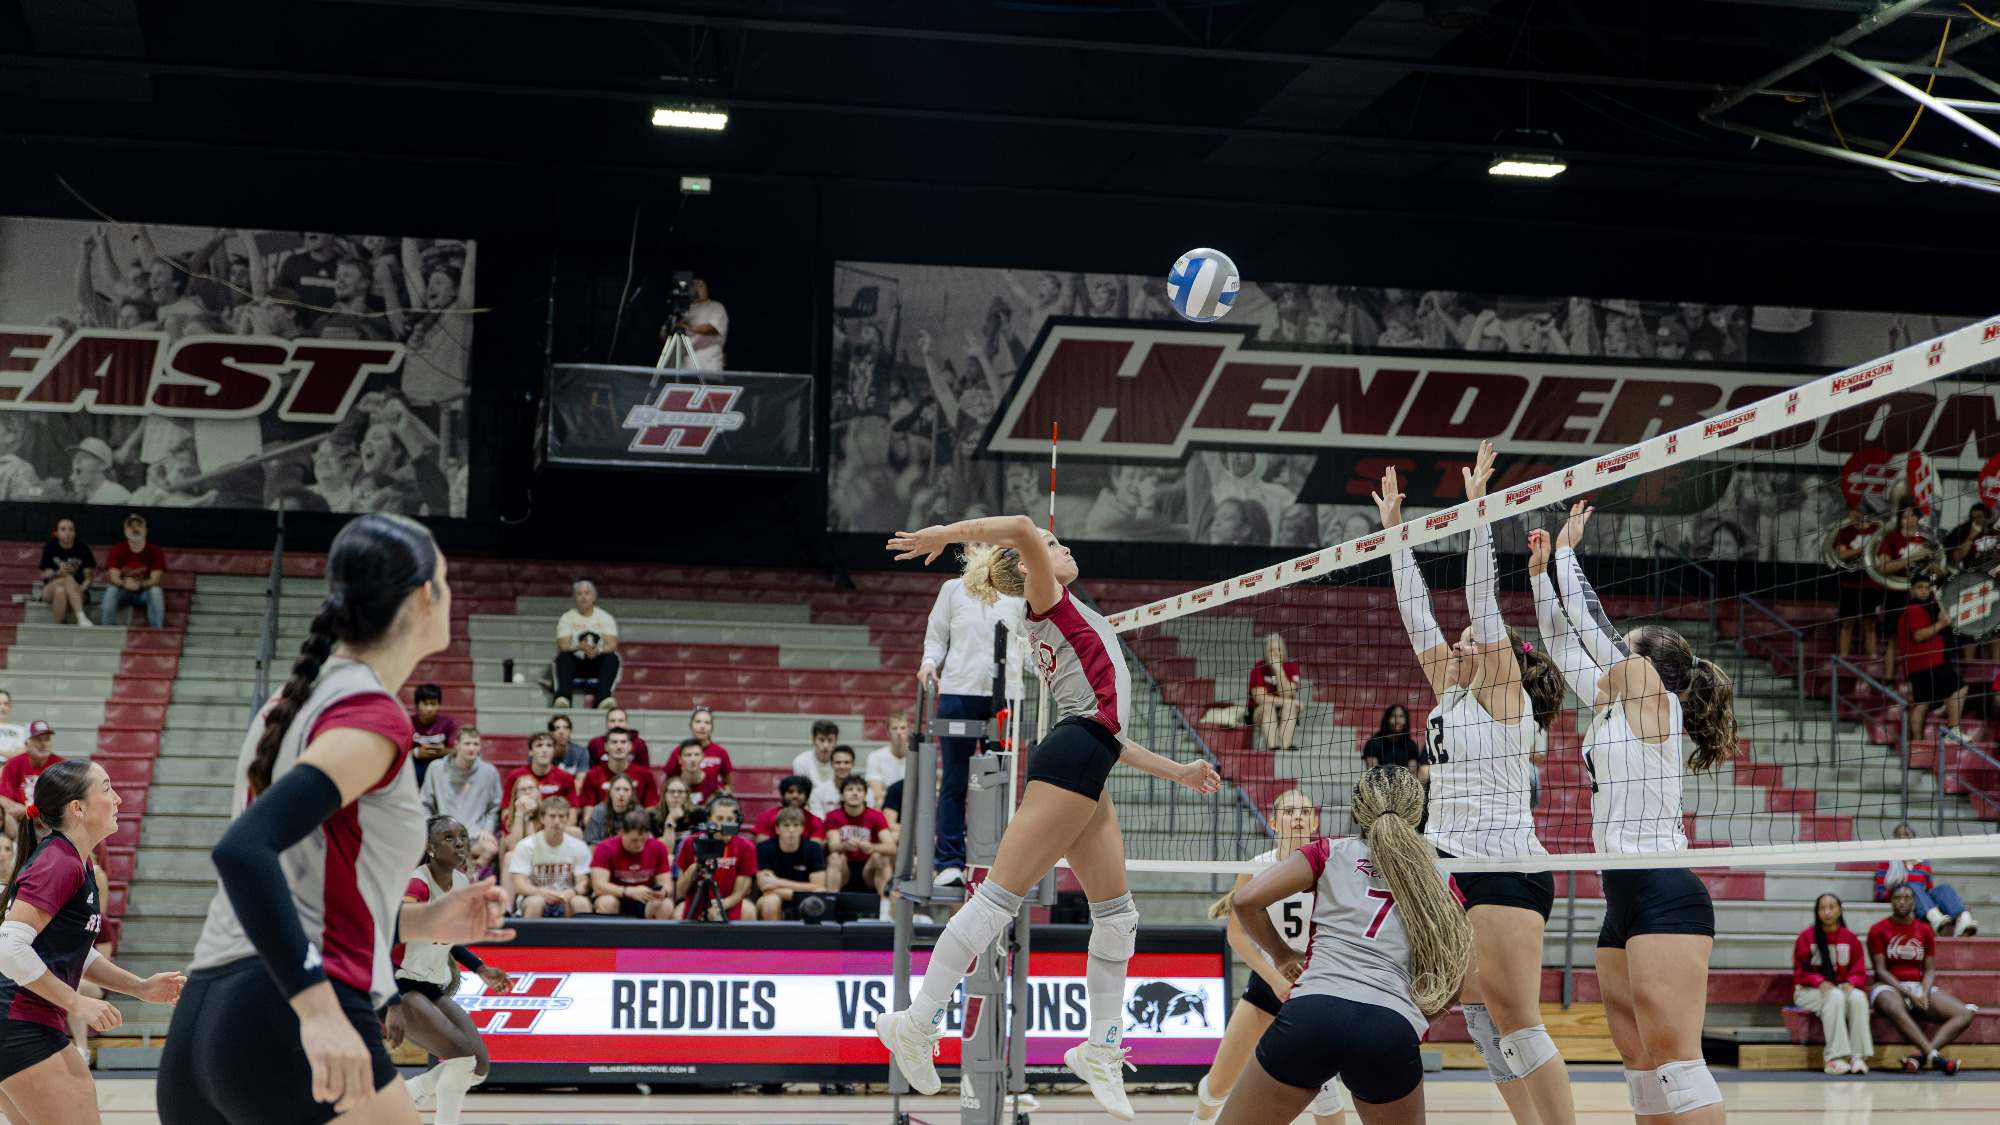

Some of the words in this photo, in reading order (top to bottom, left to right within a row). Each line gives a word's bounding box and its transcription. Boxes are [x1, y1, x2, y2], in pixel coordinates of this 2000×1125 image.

[0, 331, 397, 417] EAST
[1832, 362, 1894, 393] HENDERSON
[1704, 410, 1757, 437] HENDERSON
[1595, 450, 1640, 473] HENDERSON
[1505, 483, 1542, 503] HENDERSON
[1425, 510, 1459, 529] HENDERSON
[1283, 901, 1303, 939] 5
[1363, 887, 1398, 940] 7
[612, 979, 776, 1030] REDDIES
[836, 980, 886, 1030] VS
